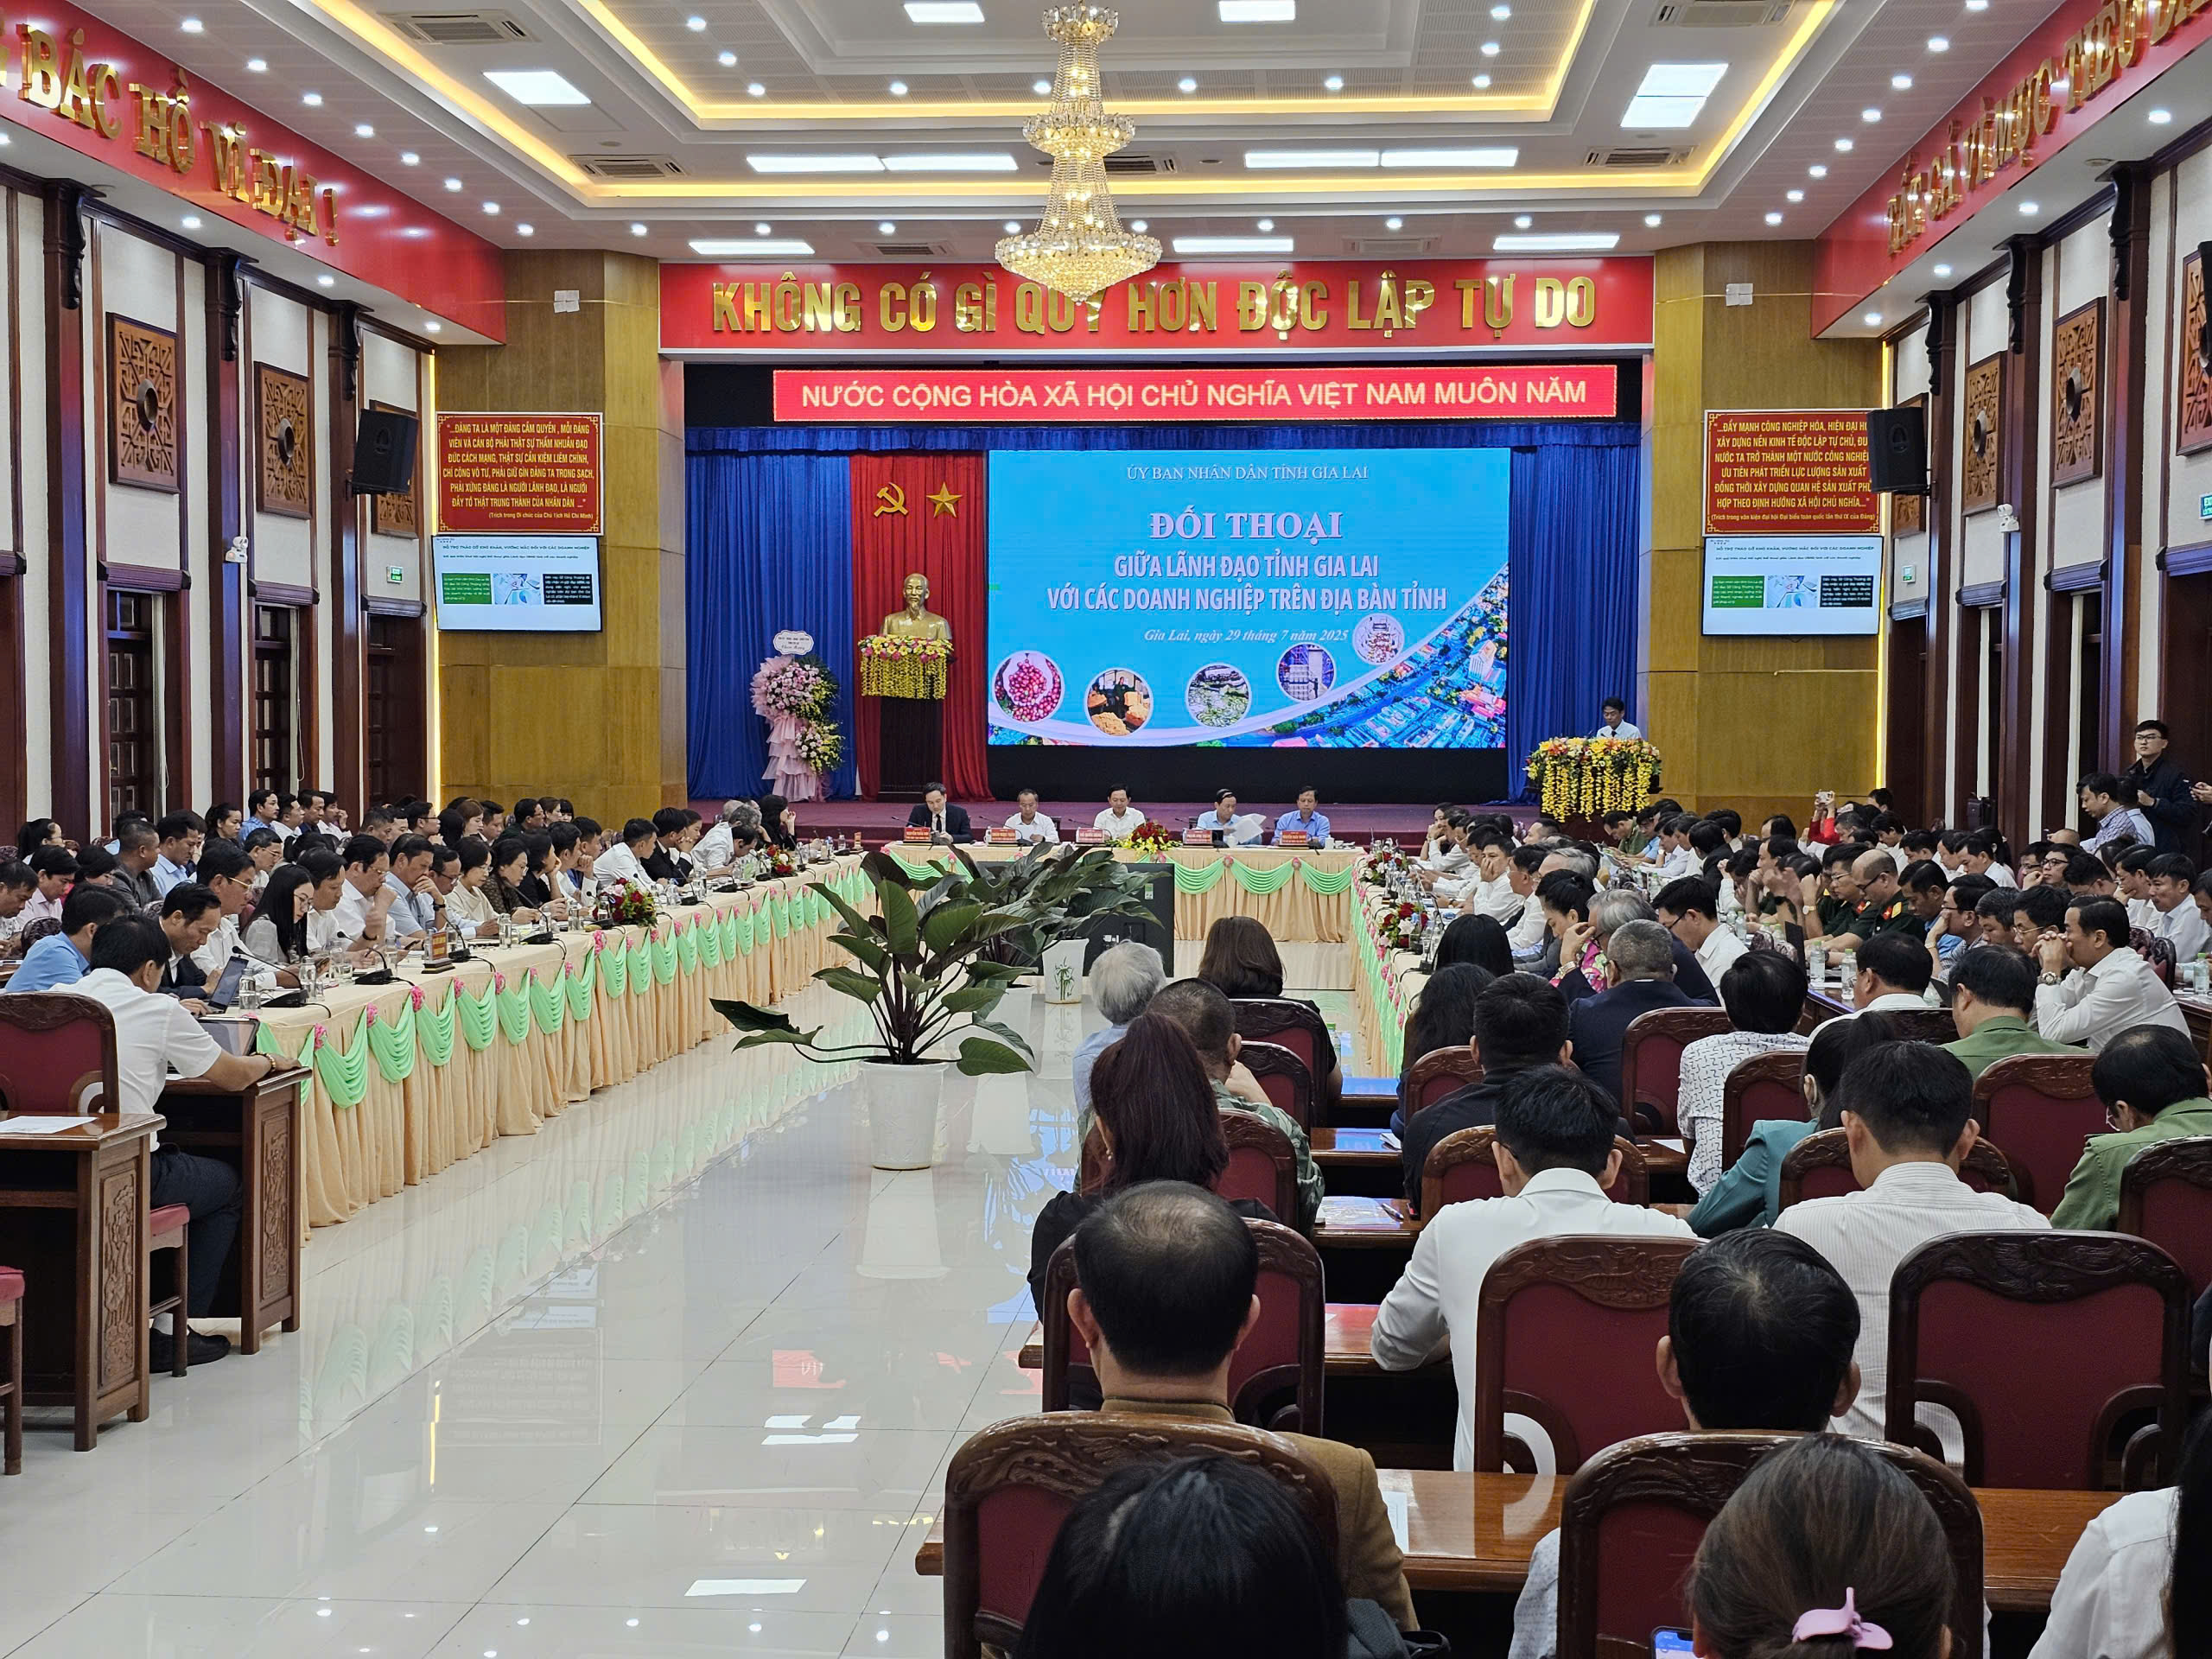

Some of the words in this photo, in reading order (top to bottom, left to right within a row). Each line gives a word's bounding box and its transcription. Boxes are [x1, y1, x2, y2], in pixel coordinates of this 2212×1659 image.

[16, 23, 123, 139] BÁC
[129, 68, 195, 173] HỒ
[712, 271, 861, 333] KHÔNG
[880, 271, 938, 333] CÓ
[955, 272, 996, 333] GÌ
[1128, 276, 1217, 331] HƠN
[1236, 269, 1328, 340] ĐỘC
[1348, 269, 1435, 338] LẬP
[1455, 273, 1516, 338] TỰ
[1535, 276, 1596, 328] DO
[802, 384, 885, 408] NƯỚC
[892, 383, 972, 412] CỘNG
[980, 383, 1038, 408] HÒA
[1043, 381, 1079, 407] XÃ
[1087, 382, 1134, 410] HỘI
[1141, 378, 1198, 407] CHỦ
[1207, 378, 1292, 406] NGHĨA
[1298, 380, 1361, 409] VIỆT
[1366, 383, 1426, 404] NAM
[1434, 380, 1522, 404] MUÔN
[1526, 378, 1586, 404] NĂM
[1738, 423, 1759, 433] MẠNH
[1761, 421, 1780, 431] CÔNG
[1846, 422, 1858, 433] ĐẠI
[1717, 435, 1730, 447] XÂY
[1769, 437, 1785, 447] KINH
[1736, 453, 1745, 462] TA
[1762, 451, 1785, 461] THÀNH
[1825, 450, 1844, 461] CÔNG
[1127, 464, 1148, 480] ỦY
[1153, 467, 1183, 480] BAN
[1188, 464, 1230, 480] NHÂN
[1236, 464, 1268, 480] DÂN
[1272, 464, 1307, 480] TỈNH
[1312, 467, 1341, 479] GIA
[1343, 466, 1368, 479] LAI
[1721, 467, 1732, 477] ƯU
[1733, 466, 1748, 477] TIÊN
[1750, 466, 1768, 477] PHÁT
[1833, 466, 1847, 476] SẢN
[1753, 481, 1767, 493] XÂY
[1790, 483, 1809, 493] QUAN
[1822, 480, 1836, 492] SẢN
[1733, 499, 1751, 508] THEO
[1752, 499, 1770, 510] ĐỊNH
[1797, 496, 1807, 507] XÃ
[1822, 496, 1836, 507] CHỦ
[1150, 505, 1217, 539] ĐỐI
[1225, 512, 1343, 545] THOẠI
[1115, 550, 1162, 577] GIỮA
[1167, 550, 1216, 577] LÃNH
[1220, 555, 1260, 583] ĐẠO
[1264, 549, 1308, 577] TỈNH
[1313, 555, 1347, 577] GIA
[1351, 555, 1379, 577] LAI
[1047, 582, 1080, 610] VỚI
[1084, 582, 1120, 610] CÁC
[1123, 588, 1191, 610] DOANH
[1196, 582, 1265, 615] NGHIỆP
[1269, 582, 1316, 610] TRÊN
[1320, 588, 1353, 615] ĐỊA
[1357, 582, 1396, 610] BÀN
[1402, 580, 1446, 610] TỈNH
[1144, 629, 1165, 641] Gia
[1168, 629, 1190, 642] Lai,
[1194, 630, 1223, 644] ngày
[1225, 629, 1241, 641] 29
[1243, 629, 1277, 644] tháng
[1281, 629, 1287, 641] 7
[1290, 629, 1316, 641] năm
[1319, 629, 1349, 641] 2025
